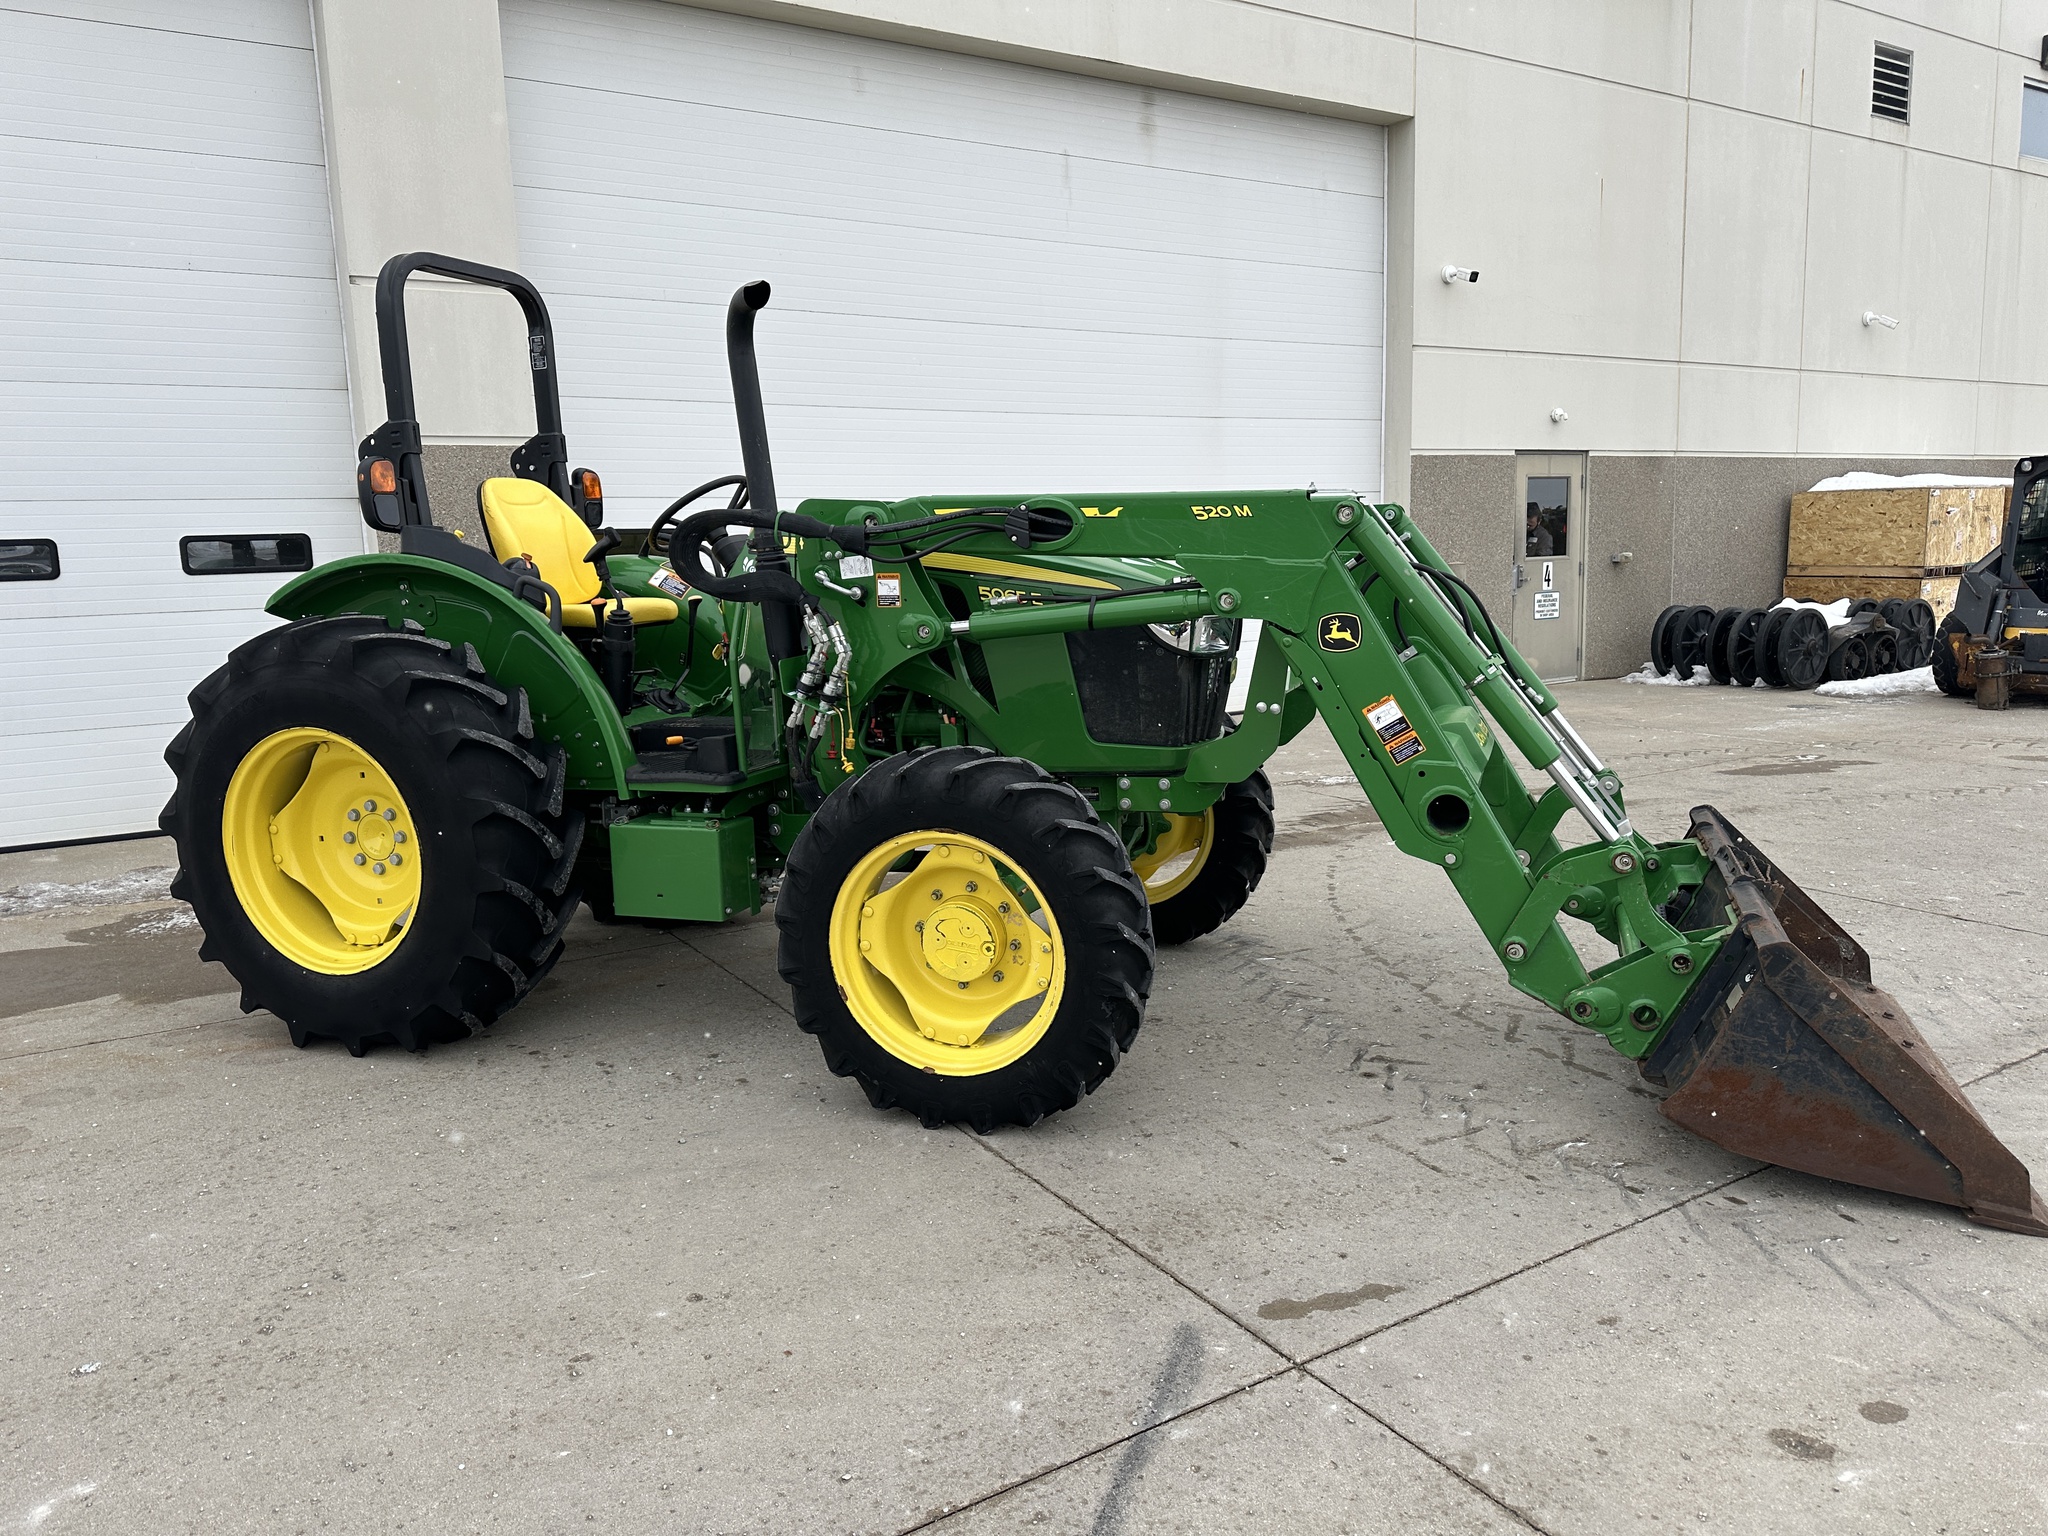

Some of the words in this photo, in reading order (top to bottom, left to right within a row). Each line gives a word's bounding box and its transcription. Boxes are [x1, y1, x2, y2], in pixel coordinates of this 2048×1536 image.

[1190, 505, 1232, 520] 520
[1233, 504, 1254, 517] M
[1544, 564, 1551, 588] 4
